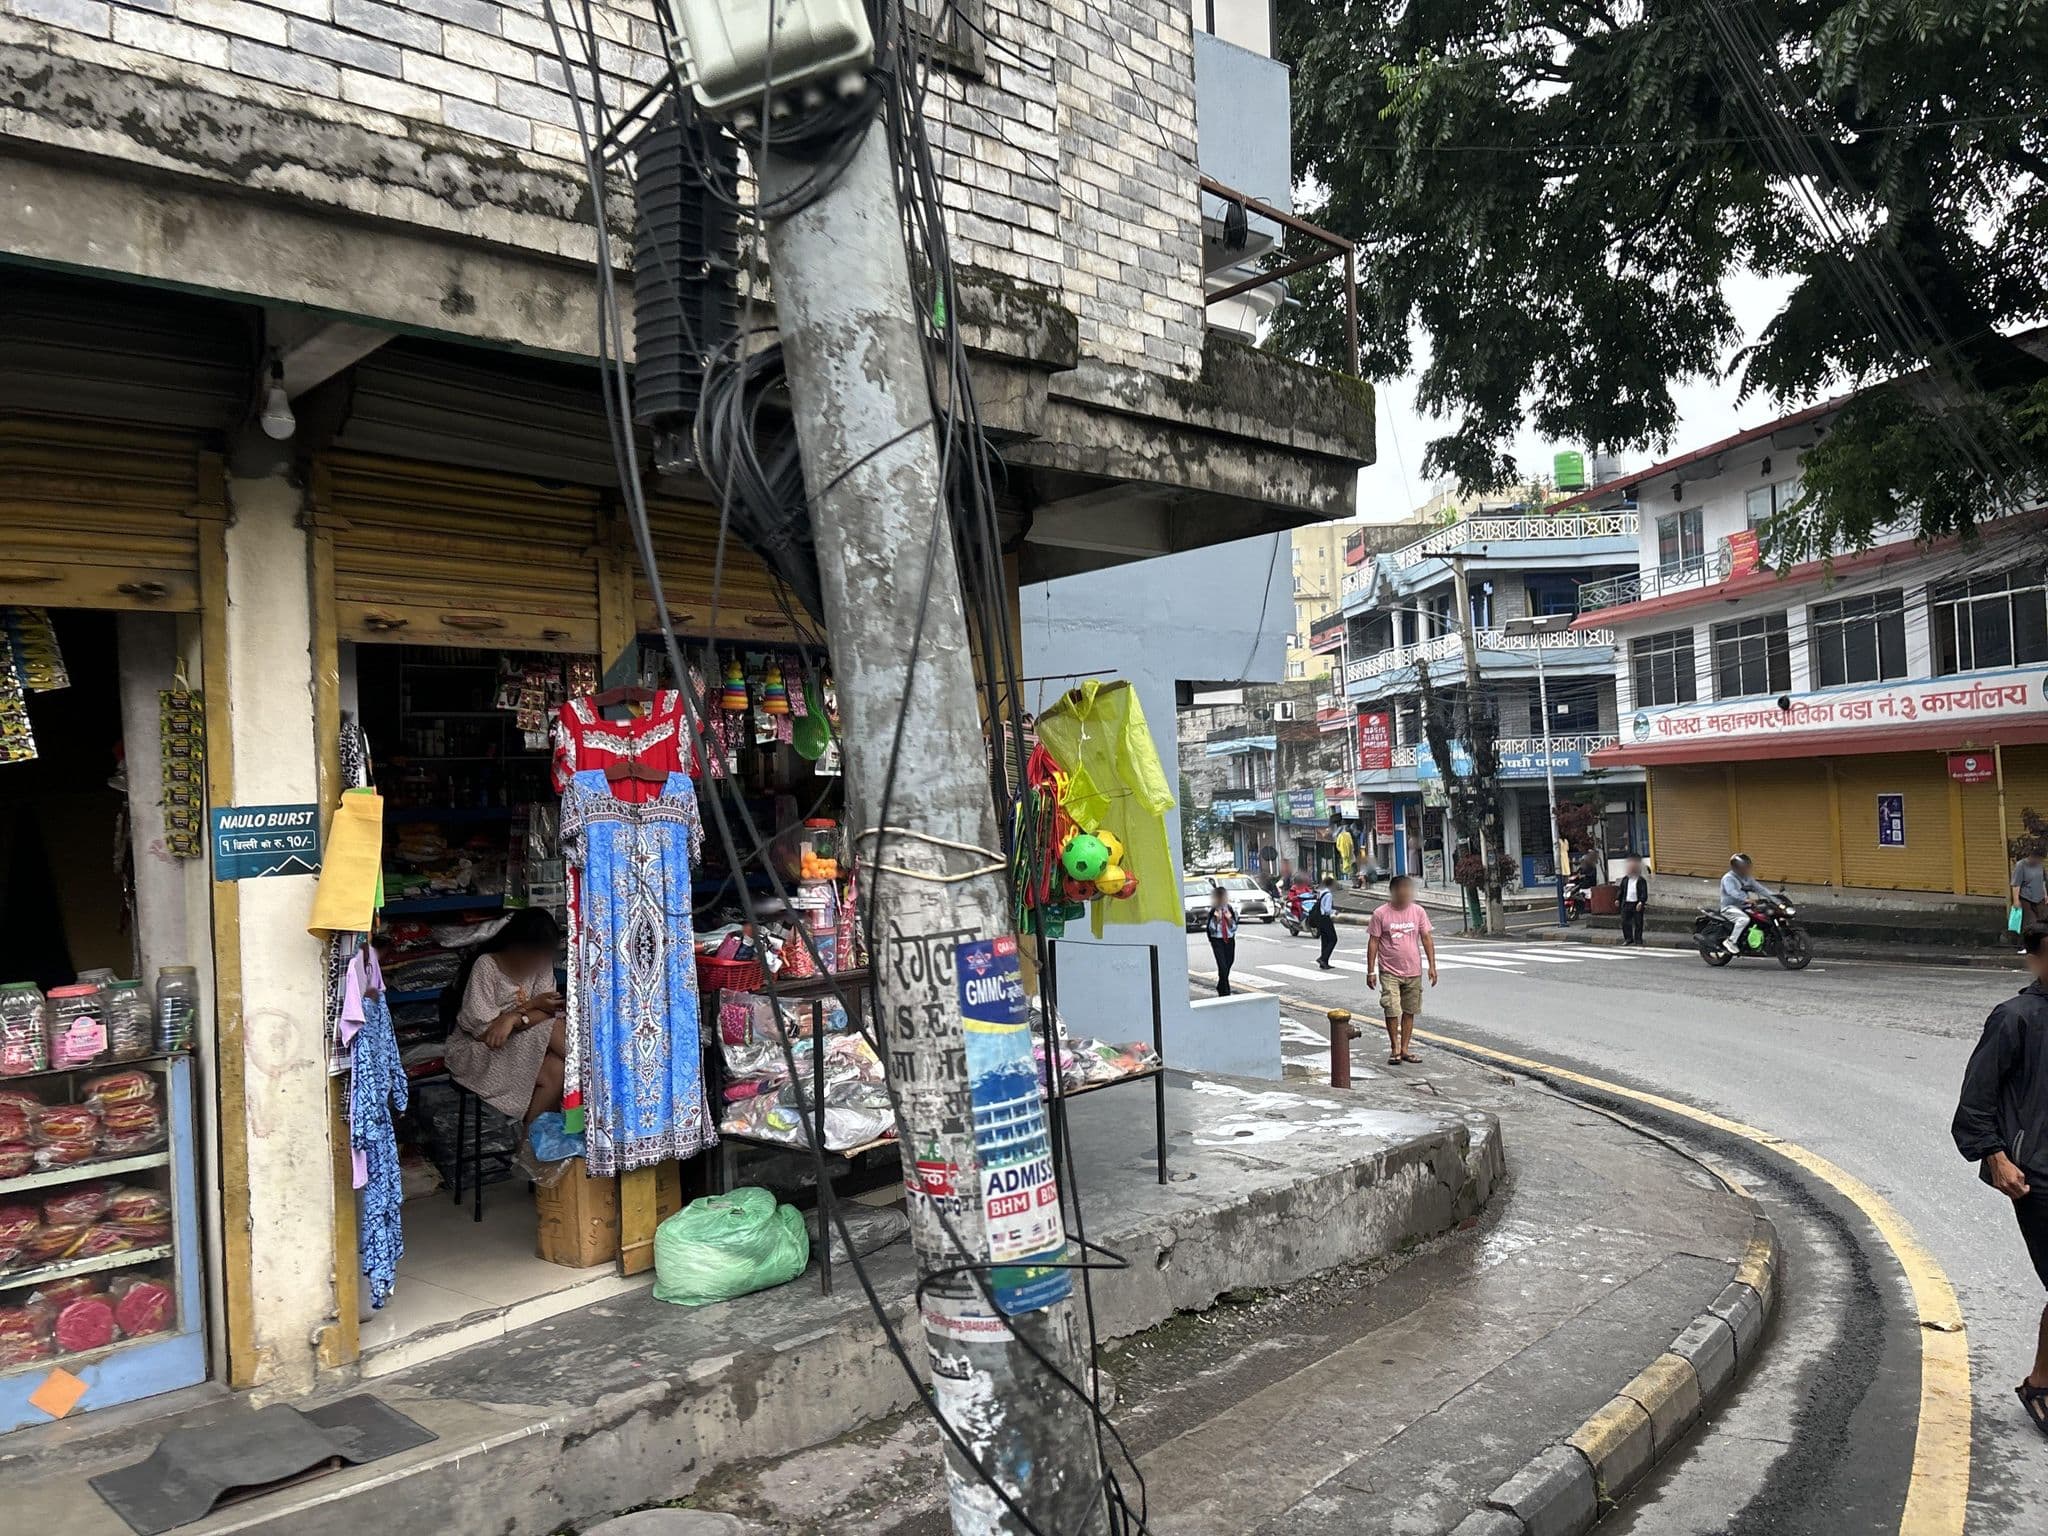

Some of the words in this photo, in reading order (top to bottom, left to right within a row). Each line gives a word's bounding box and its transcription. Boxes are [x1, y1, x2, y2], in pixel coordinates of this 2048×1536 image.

[1657, 715, 1701, 736] पोखरा
[1708, 702, 1834, 733] महानगरपालिका
[1839, 700, 1872, 720] वडा
[1920, 682, 2027, 712] कार्यालय
[219, 814, 266, 829] NAULO
[267, 812, 314, 826] BURST
[965, 975, 1006, 1006] GMMC
[990, 1195, 1028, 1217] BHM
